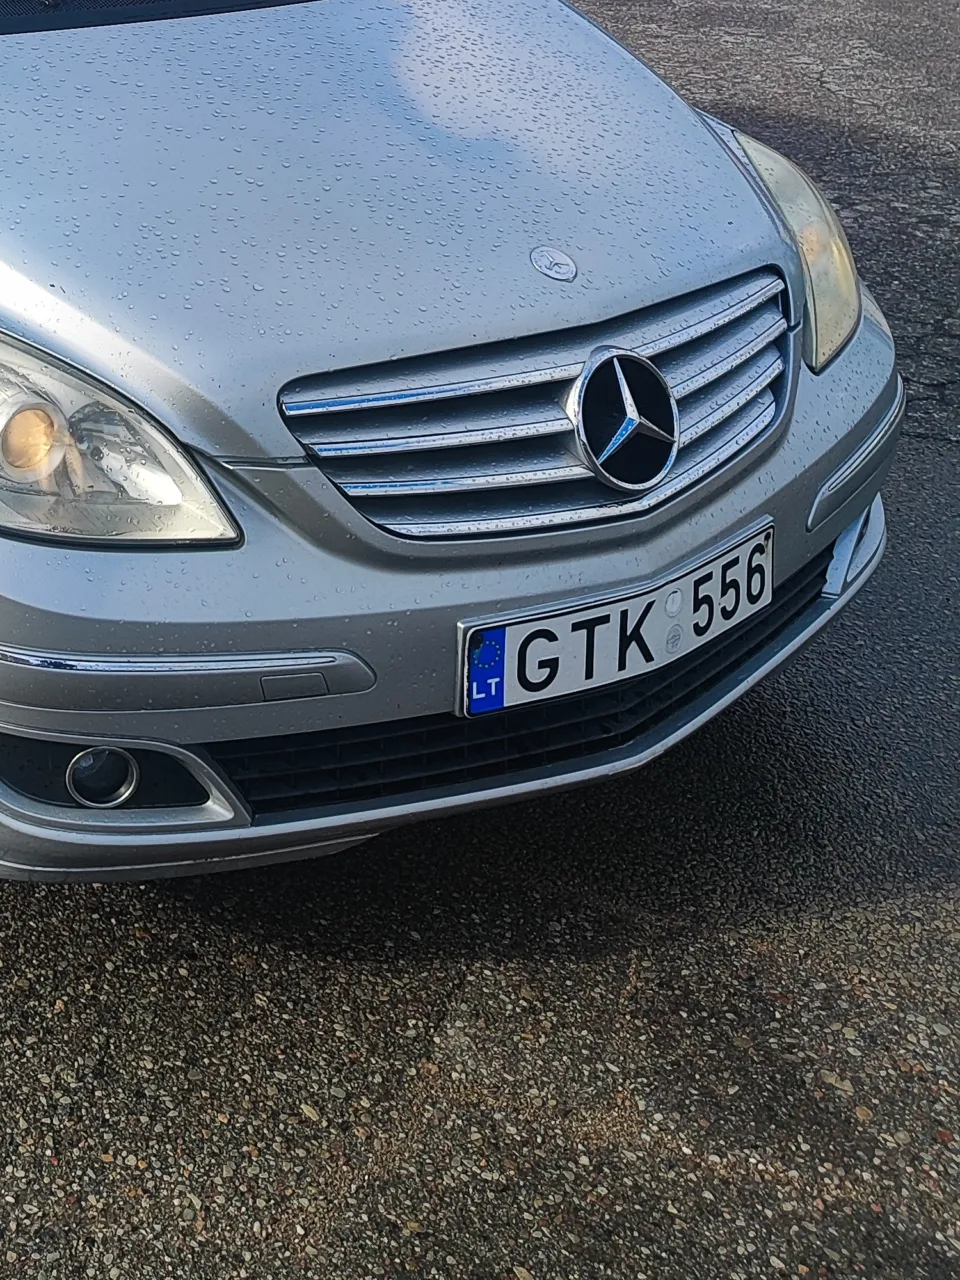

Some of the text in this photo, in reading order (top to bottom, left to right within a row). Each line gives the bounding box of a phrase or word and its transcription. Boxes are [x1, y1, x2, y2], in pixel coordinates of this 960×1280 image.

[516, 542, 767, 693] GTK 556
[472, 677, 501, 700] LT
